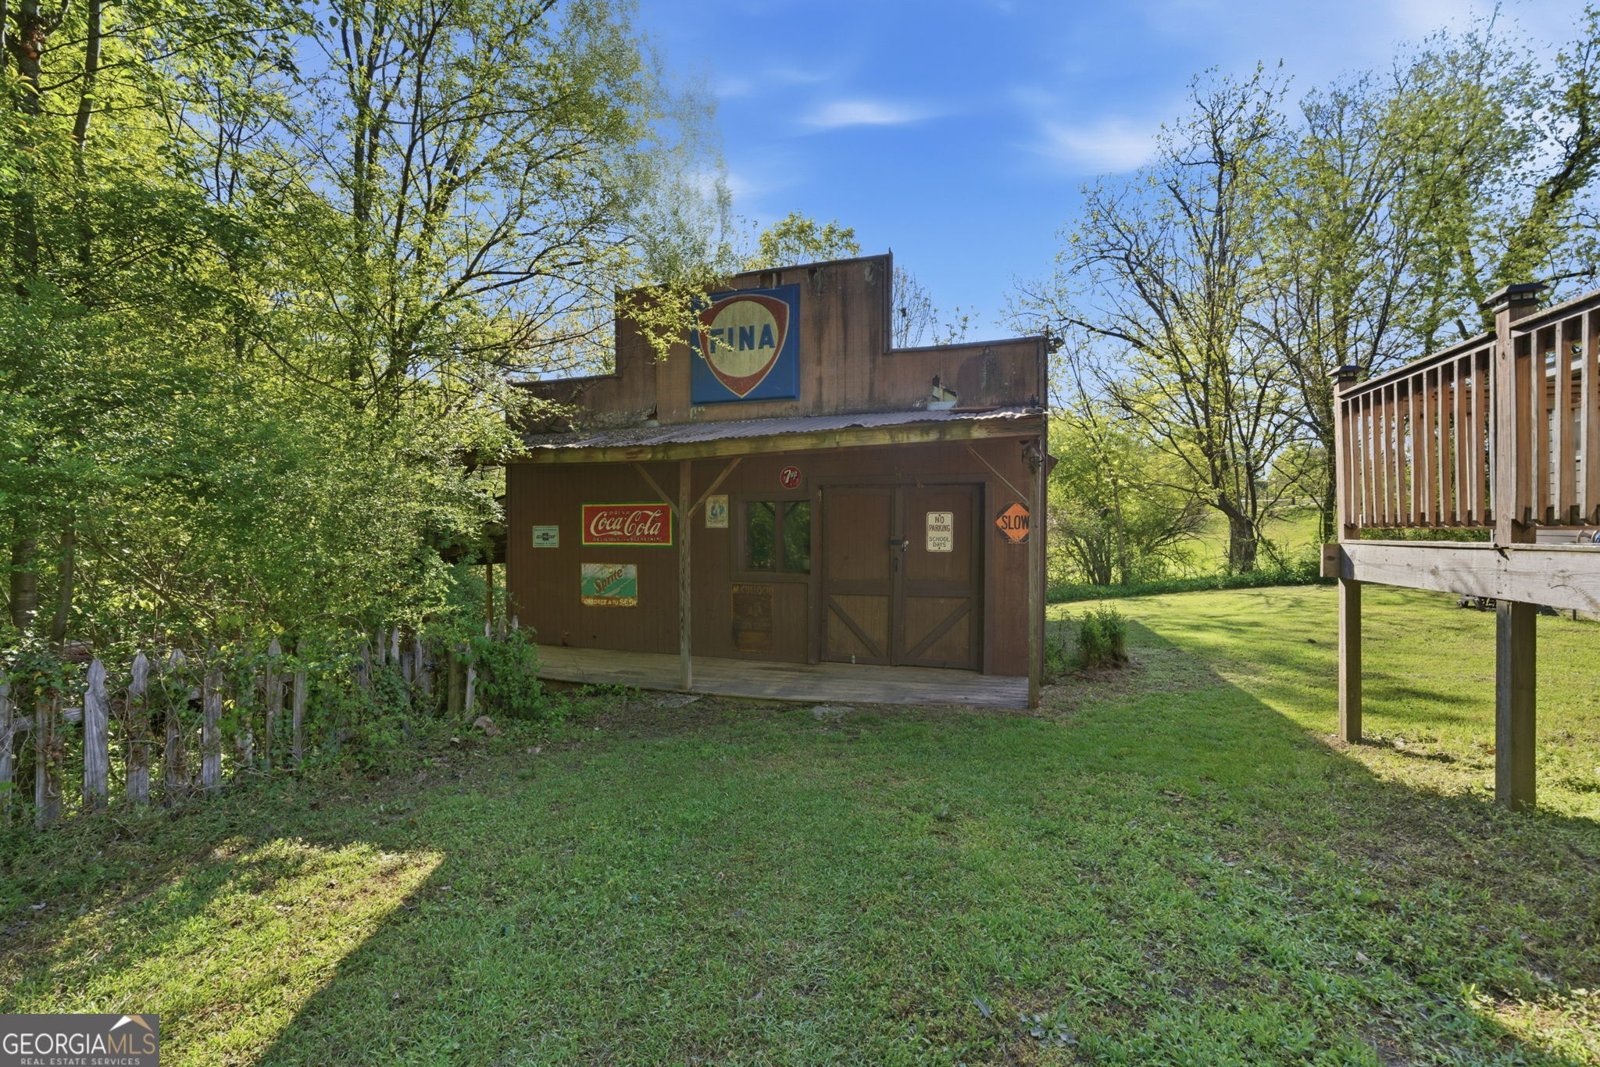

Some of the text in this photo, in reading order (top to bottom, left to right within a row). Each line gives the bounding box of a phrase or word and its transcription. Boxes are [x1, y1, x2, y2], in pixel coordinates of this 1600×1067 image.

[709, 323, 776, 354] FINA
[929, 524, 951, 532] PARKING
[1001, 515, 1029, 530] SLOW
[594, 568, 623, 594] Sprite
